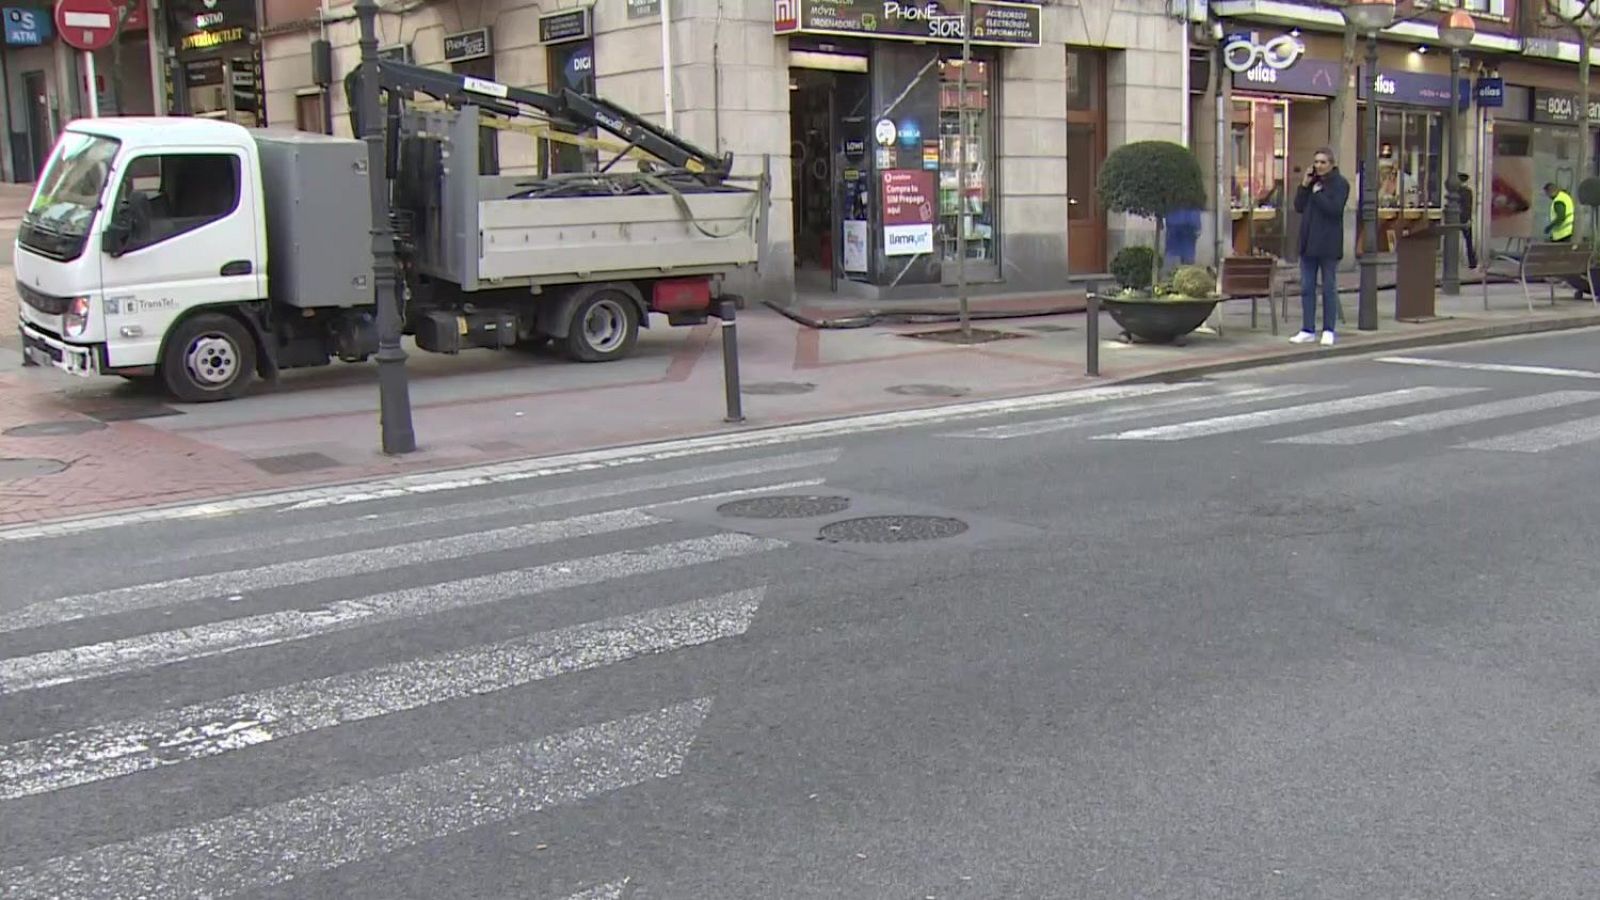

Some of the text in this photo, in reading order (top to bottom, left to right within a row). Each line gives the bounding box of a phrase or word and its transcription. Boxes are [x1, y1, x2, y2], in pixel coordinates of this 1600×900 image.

[811, 6, 837, 16] MÓVIL
[884, 2, 937, 20] PHONE
[986, 10, 1027, 20] ACCESORIOS
[810, 18, 861, 28] ORDENADORES
[986, 18, 1030, 28] ELECTRÓNICA
[12, 32, 37, 41] ATM
[211, 27, 242, 46] OUTLET
[986, 27, 1033, 38] INFORMÁTICA
[573, 56, 591, 71] DIGI
[1548, 97, 1572, 116] BOCA
[886, 184, 918, 194] Compra tu
[886, 194, 925, 205] SIM Prepago
